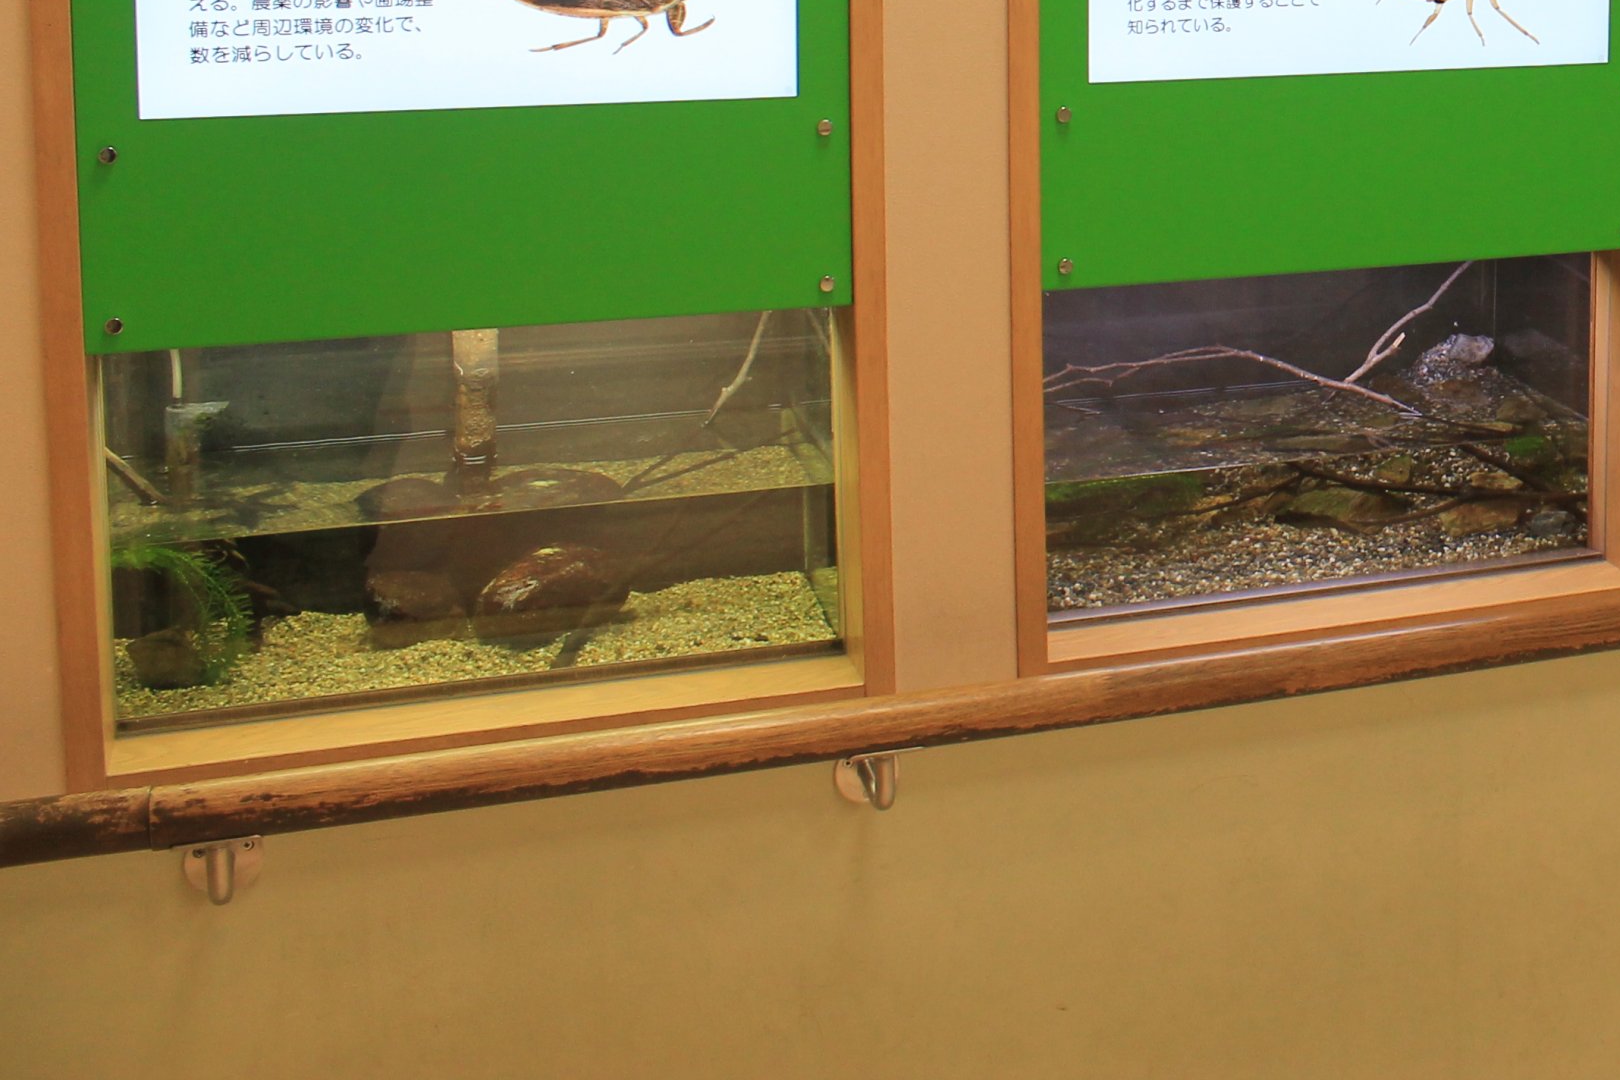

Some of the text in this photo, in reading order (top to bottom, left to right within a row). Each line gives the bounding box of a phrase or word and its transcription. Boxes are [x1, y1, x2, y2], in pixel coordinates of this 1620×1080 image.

[189, 15, 425, 38] 備など周辺環境の変化で、
[1128, 16, 1234, 36] 知られている。
[190, 41, 365, 65] 数を減らしている。
